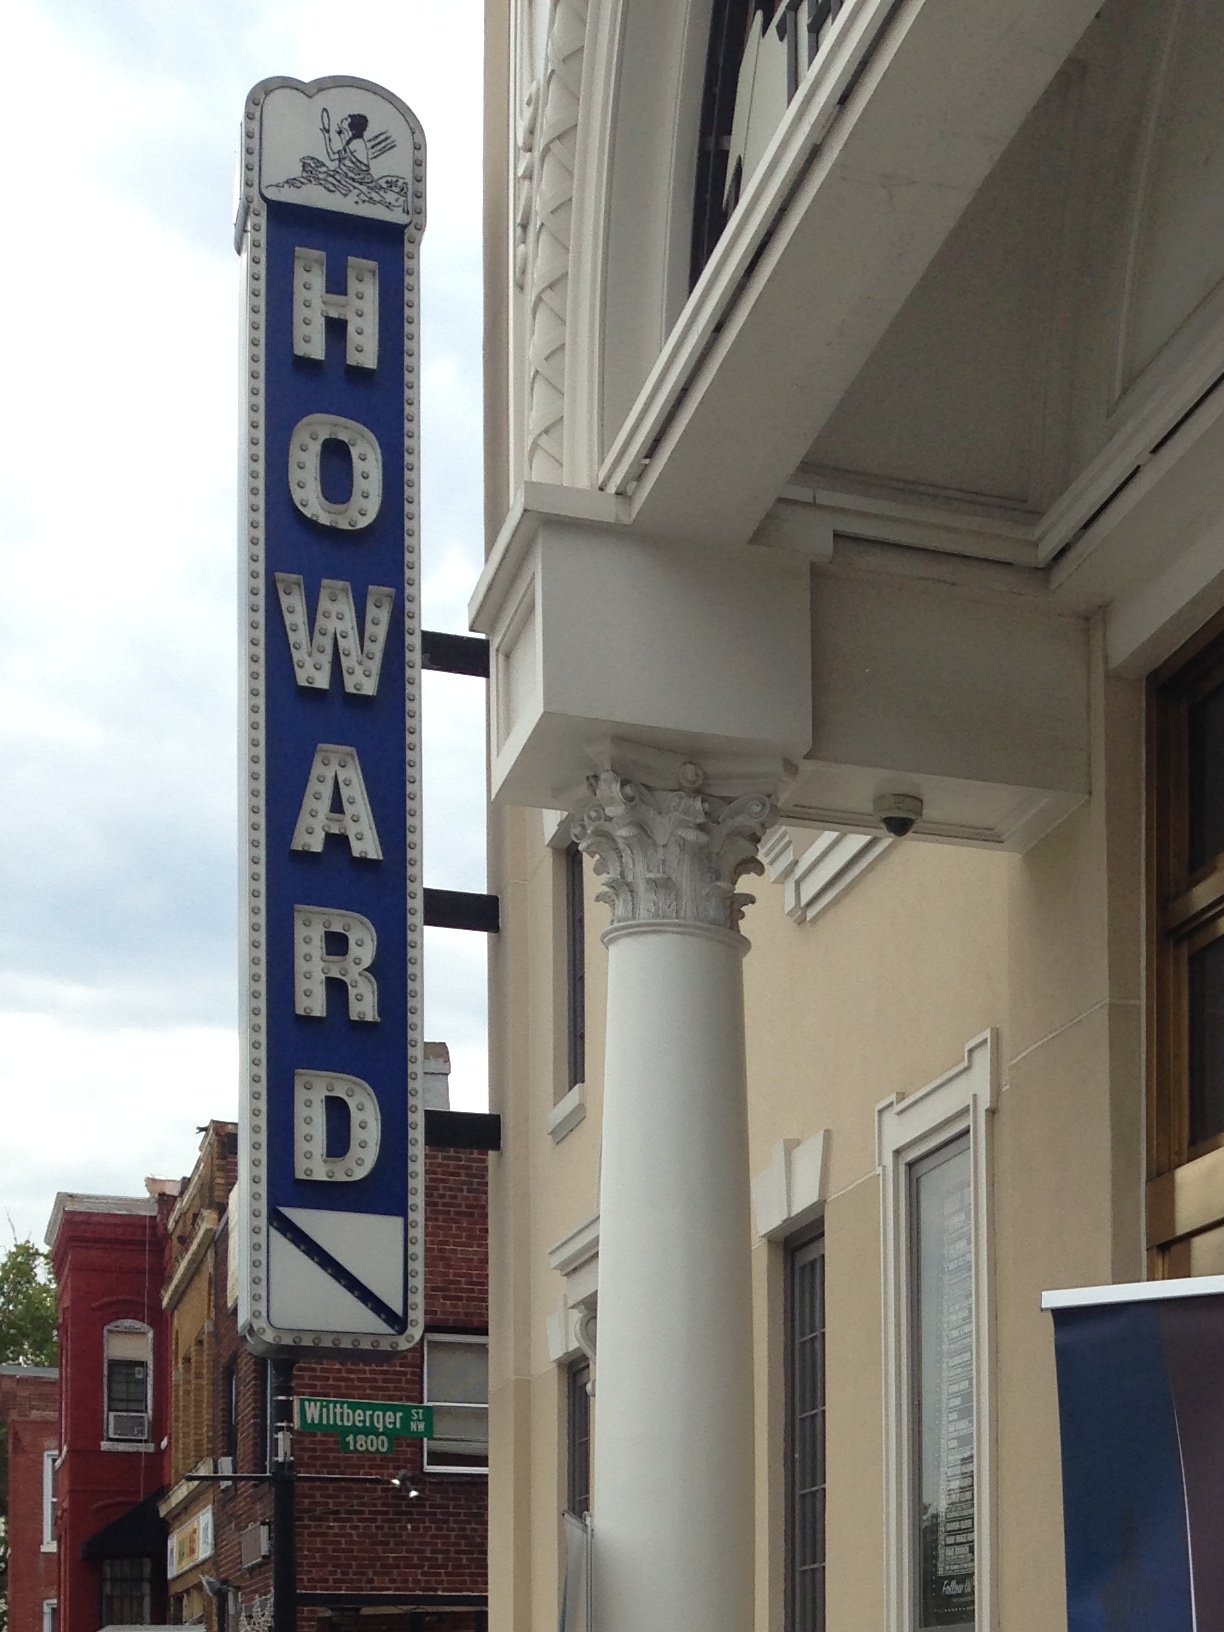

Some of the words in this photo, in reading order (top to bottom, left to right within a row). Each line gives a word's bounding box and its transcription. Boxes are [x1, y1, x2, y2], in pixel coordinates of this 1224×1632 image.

[274, 246, 396, 1184] HOWARD
[304, 1400, 403, 1432] Wiltberger
[411, 1408, 424, 1420] ST
[410, 1421, 426, 1432] NW
[345, 1434, 388, 1452] 1800
